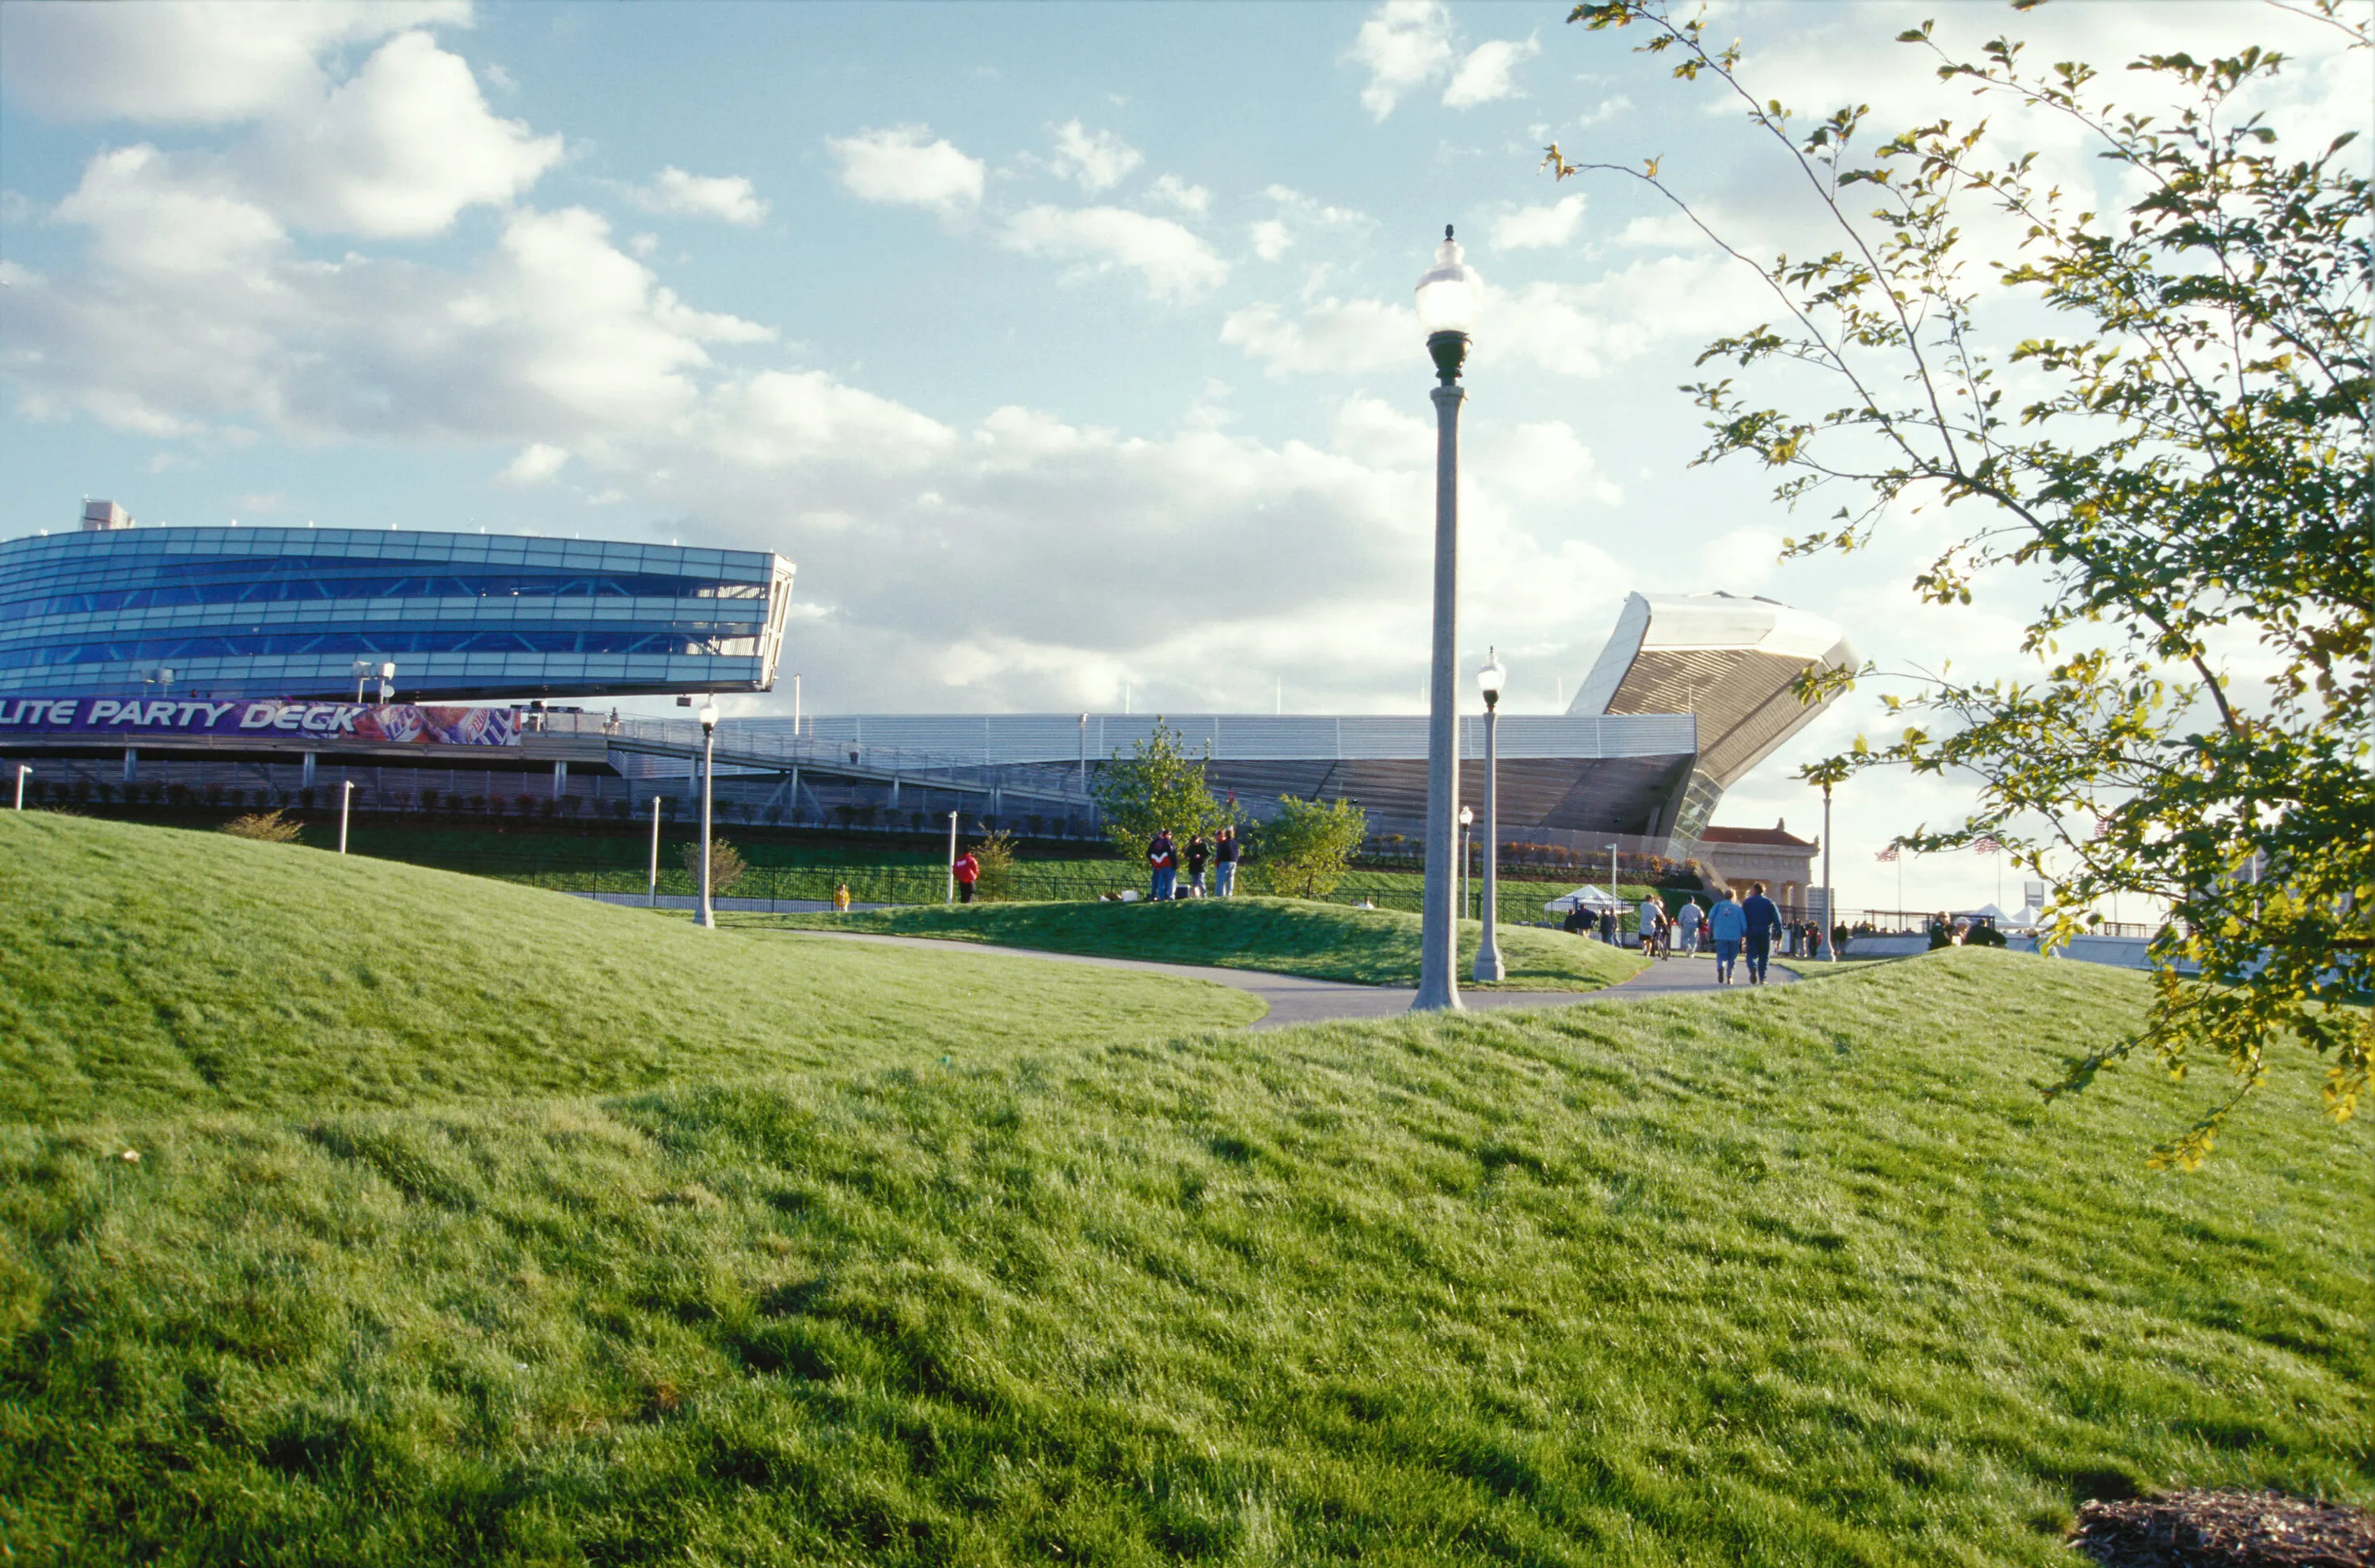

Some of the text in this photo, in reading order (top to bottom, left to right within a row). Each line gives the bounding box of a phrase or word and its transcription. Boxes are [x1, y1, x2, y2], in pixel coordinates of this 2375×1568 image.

[0, 700, 78, 724] LITE
[86, 700, 236, 727] PARTY
[239, 704, 367, 731] DECK
